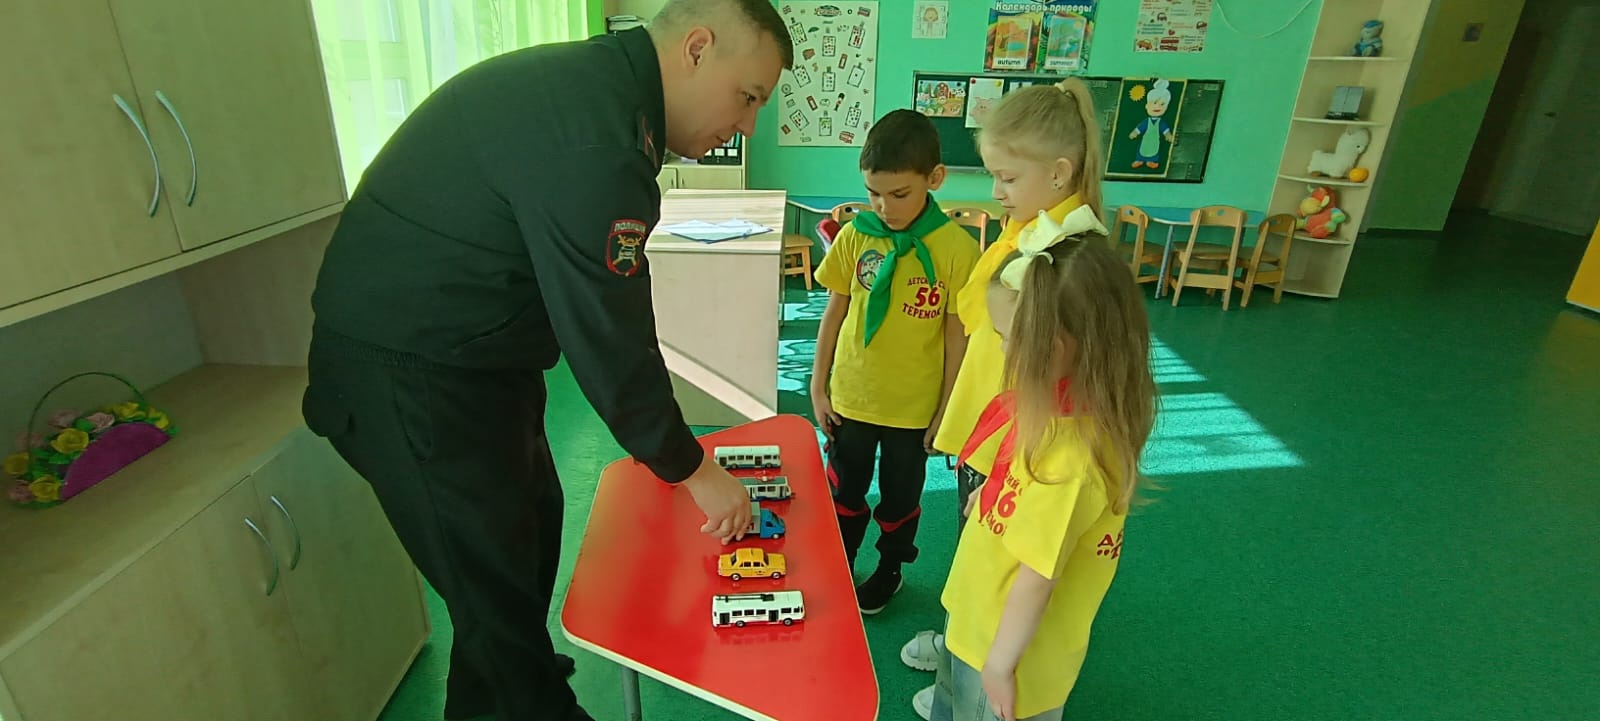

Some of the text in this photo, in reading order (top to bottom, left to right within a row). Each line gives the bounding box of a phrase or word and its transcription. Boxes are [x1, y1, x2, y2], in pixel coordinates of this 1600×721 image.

[1049, 4, 1092, 14] природы
[914, 286, 940, 308] 56
[998, 490, 1017, 518] 6
